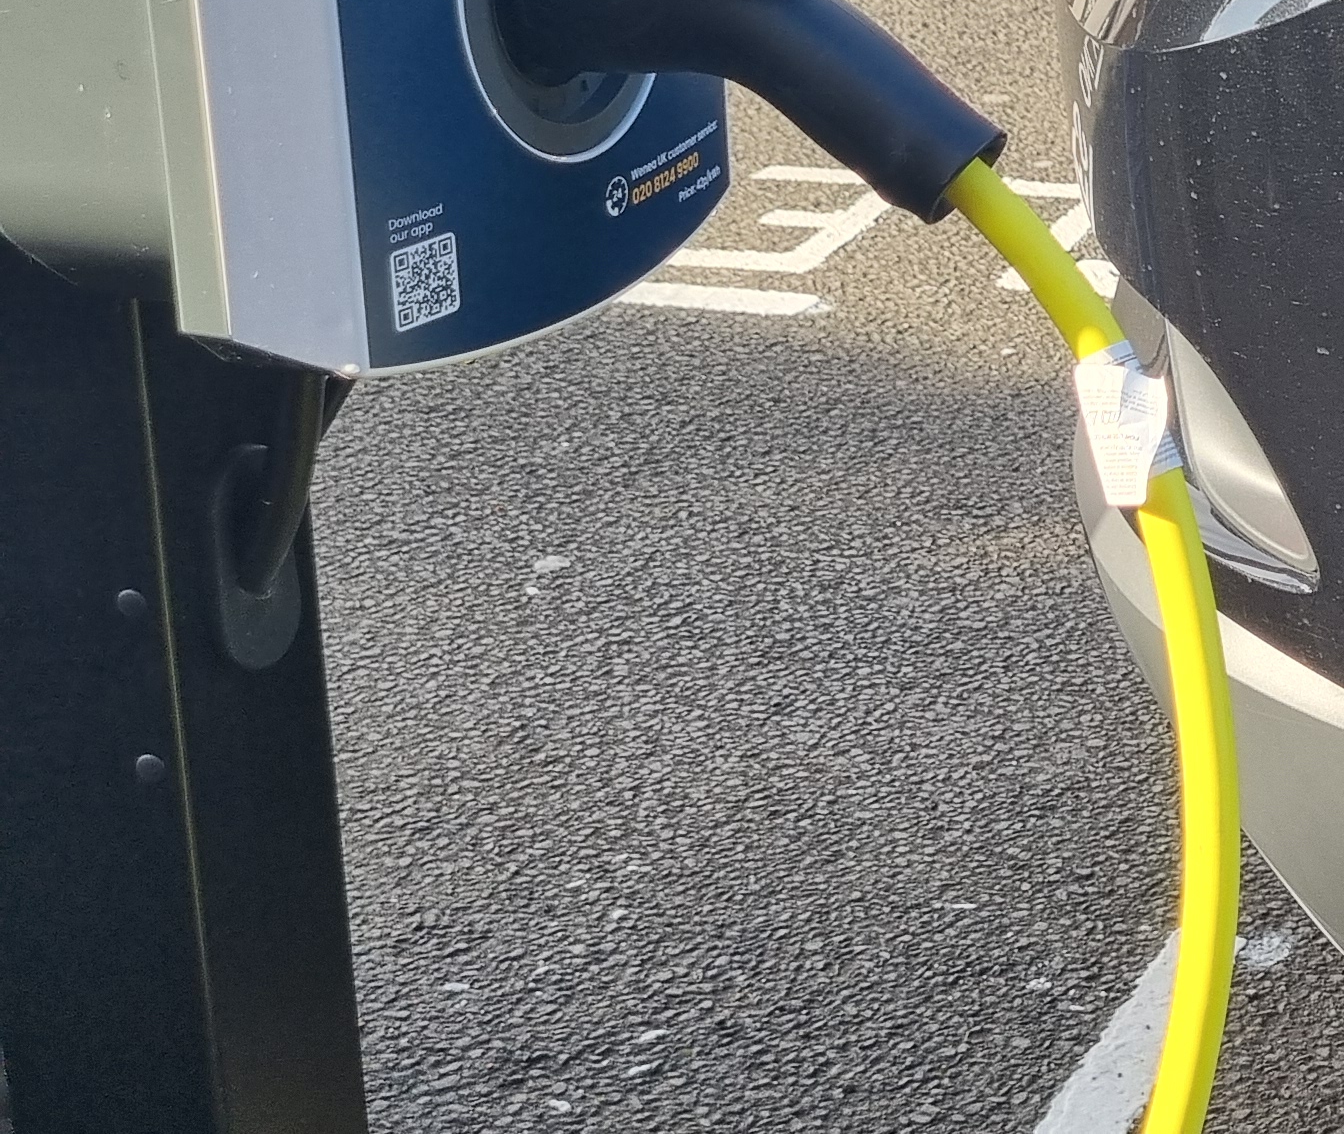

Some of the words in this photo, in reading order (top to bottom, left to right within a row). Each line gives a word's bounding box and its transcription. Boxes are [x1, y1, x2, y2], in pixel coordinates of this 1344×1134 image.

[631, 159, 657, 181] Wenea
[657, 152, 668, 166] UK
[668, 135, 697, 160] customer
[632, 180, 652, 205] 020
[654, 167, 675, 193] 8124
[677, 151, 699, 178] 9900
[612, 188, 623, 202] 24
[388, 203, 443, 231] Download
[390, 230, 408, 244] our
[411, 222, 433, 238] app
